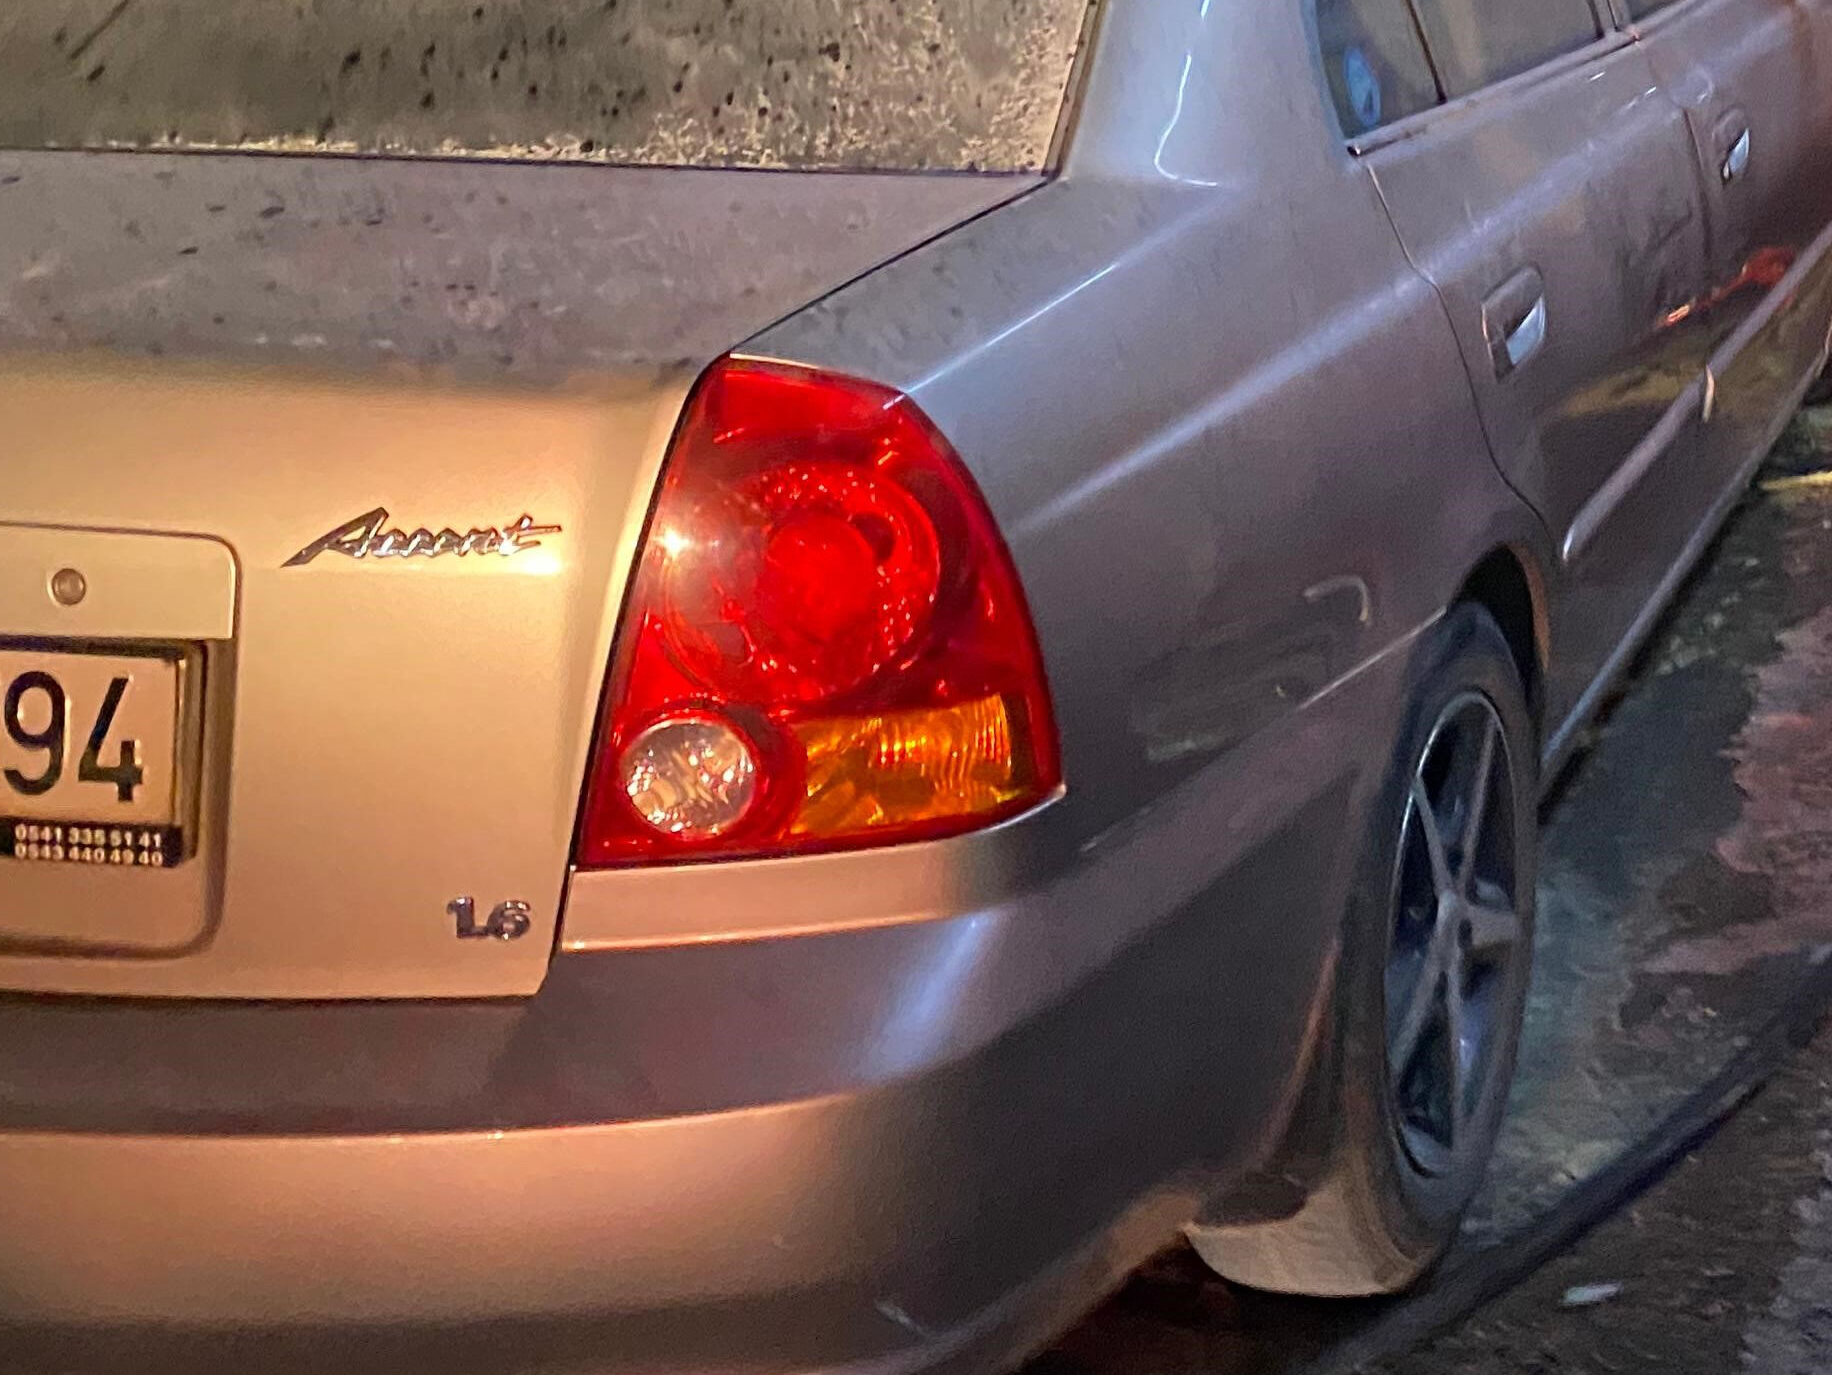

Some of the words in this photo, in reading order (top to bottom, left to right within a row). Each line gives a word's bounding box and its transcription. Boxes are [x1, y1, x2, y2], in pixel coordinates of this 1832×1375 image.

[4, 671, 143, 802] 94
[138, 831, 161, 848] 41
[138, 850, 163, 866] 40
